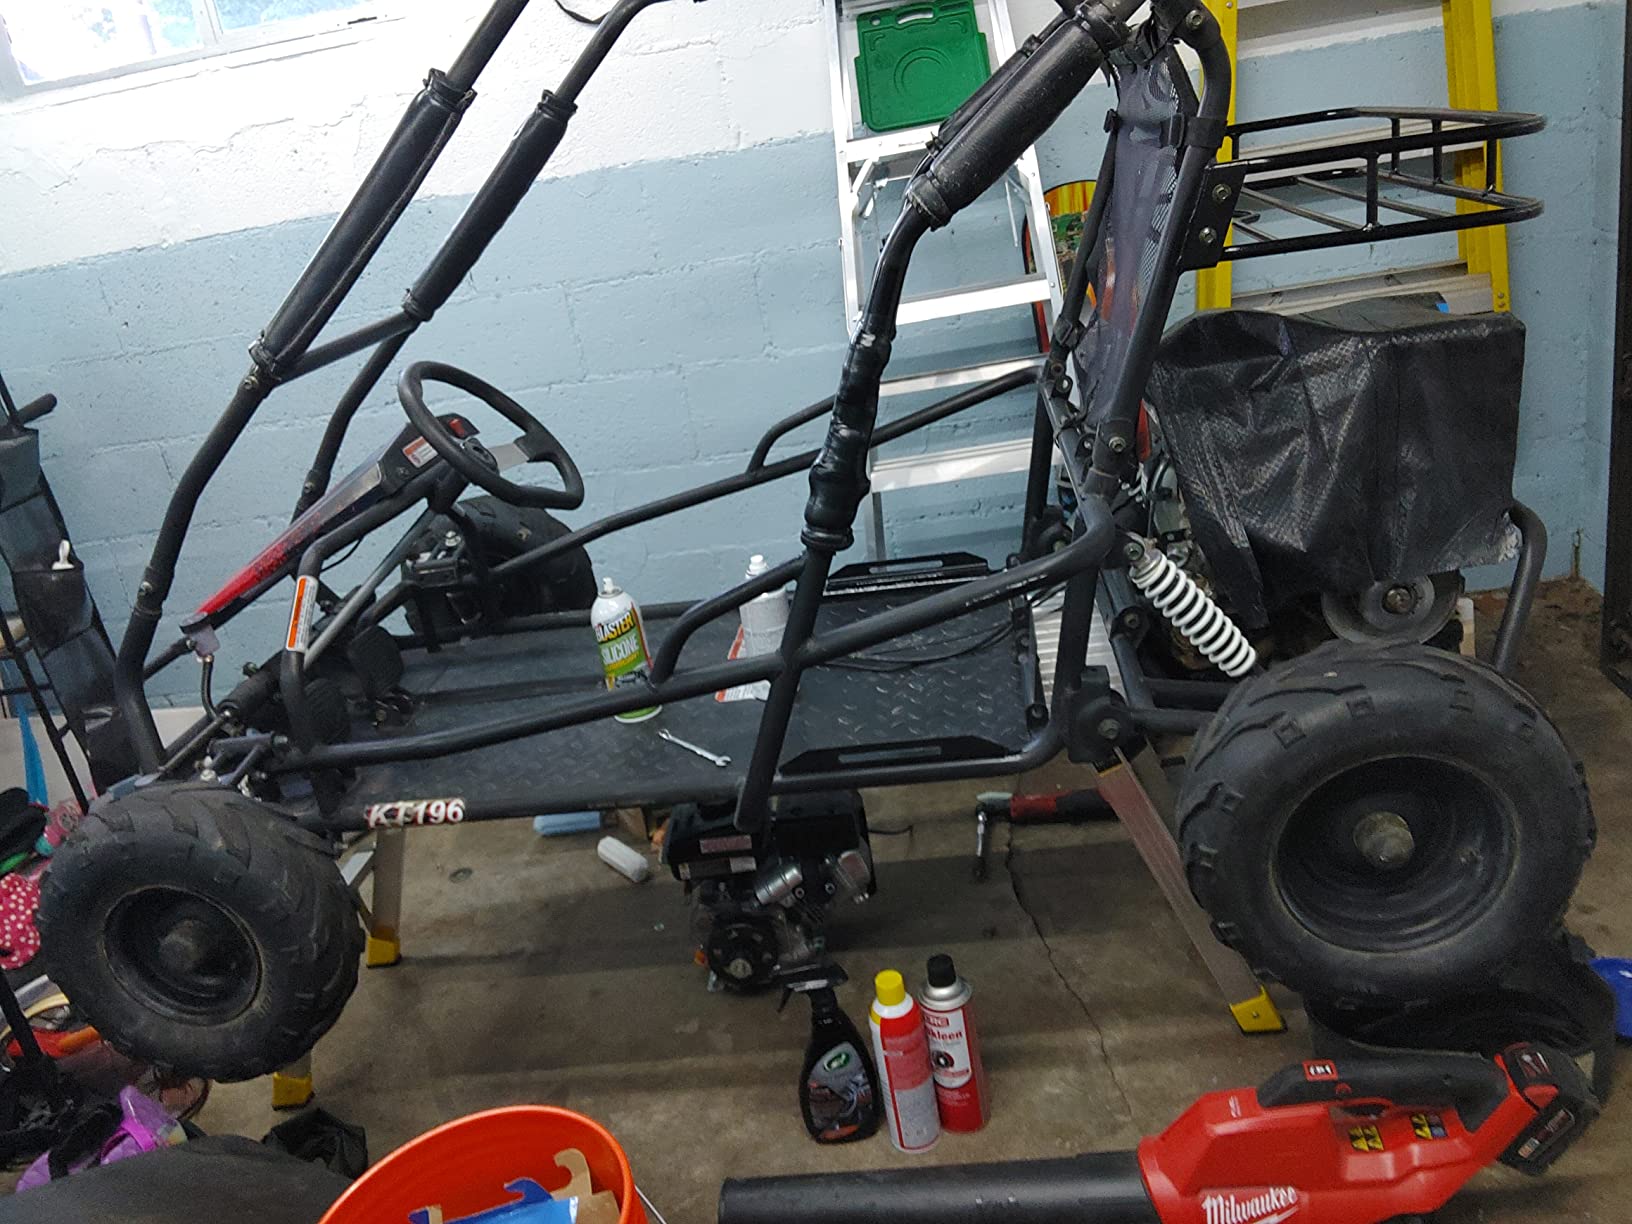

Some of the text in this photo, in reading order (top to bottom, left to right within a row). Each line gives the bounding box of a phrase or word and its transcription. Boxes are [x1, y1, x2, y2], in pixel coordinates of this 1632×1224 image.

[595, 612, 634, 642] BLASTER
[601, 633, 639, 665] SILICONE
[366, 798, 465, 828] KT196
[1201, 1186, 1298, 1224] Milwaukee
